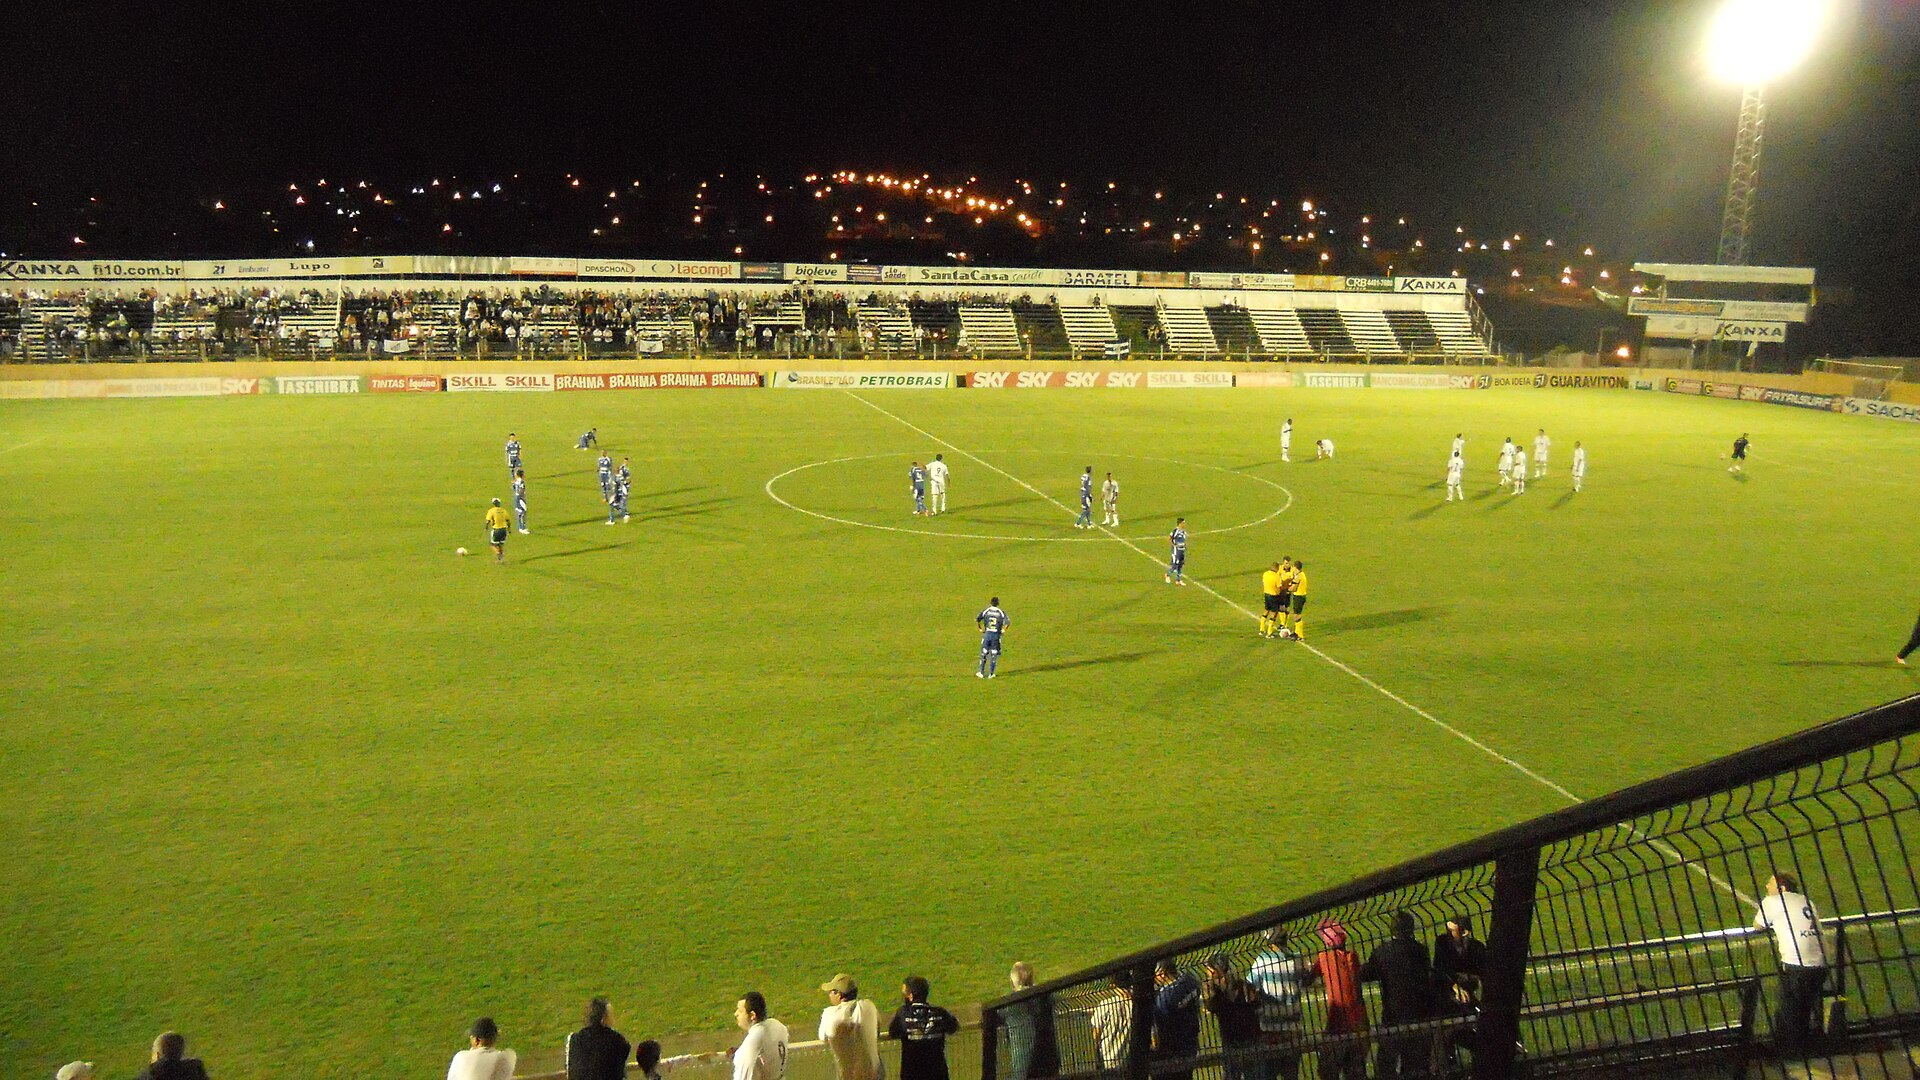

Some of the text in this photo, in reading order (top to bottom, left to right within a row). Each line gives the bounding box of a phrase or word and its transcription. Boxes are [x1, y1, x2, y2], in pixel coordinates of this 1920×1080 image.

[0, 261, 80, 280] KANXA
[93, 264, 181, 276] fi10.com.br
[213, 265, 226, 275] 21
[290, 262, 331, 273] Lupo
[1346, 277, 1367, 287] CRB
[1401, 279, 1457, 291] KANXA
[1715, 324, 1783, 339] KANXA
[276, 376, 360, 394] TASCHIBRA
[371, 379, 405, 388] TINTAS
[452, 375, 551, 387] SKILL SKILL
[557, 373, 759, 389] BRAHMA BRAHMA BRAHMA BRAHMA
[860, 376, 943, 386] PETROBRAS
[972, 372, 1143, 388] SKY SKY SKY SKY
[1150, 374, 1187, 384] SKILL
[1193, 374, 1229, 384] SKILL
[222, 379, 257, 395] SKY
[988, 617, 997, 629] 2
